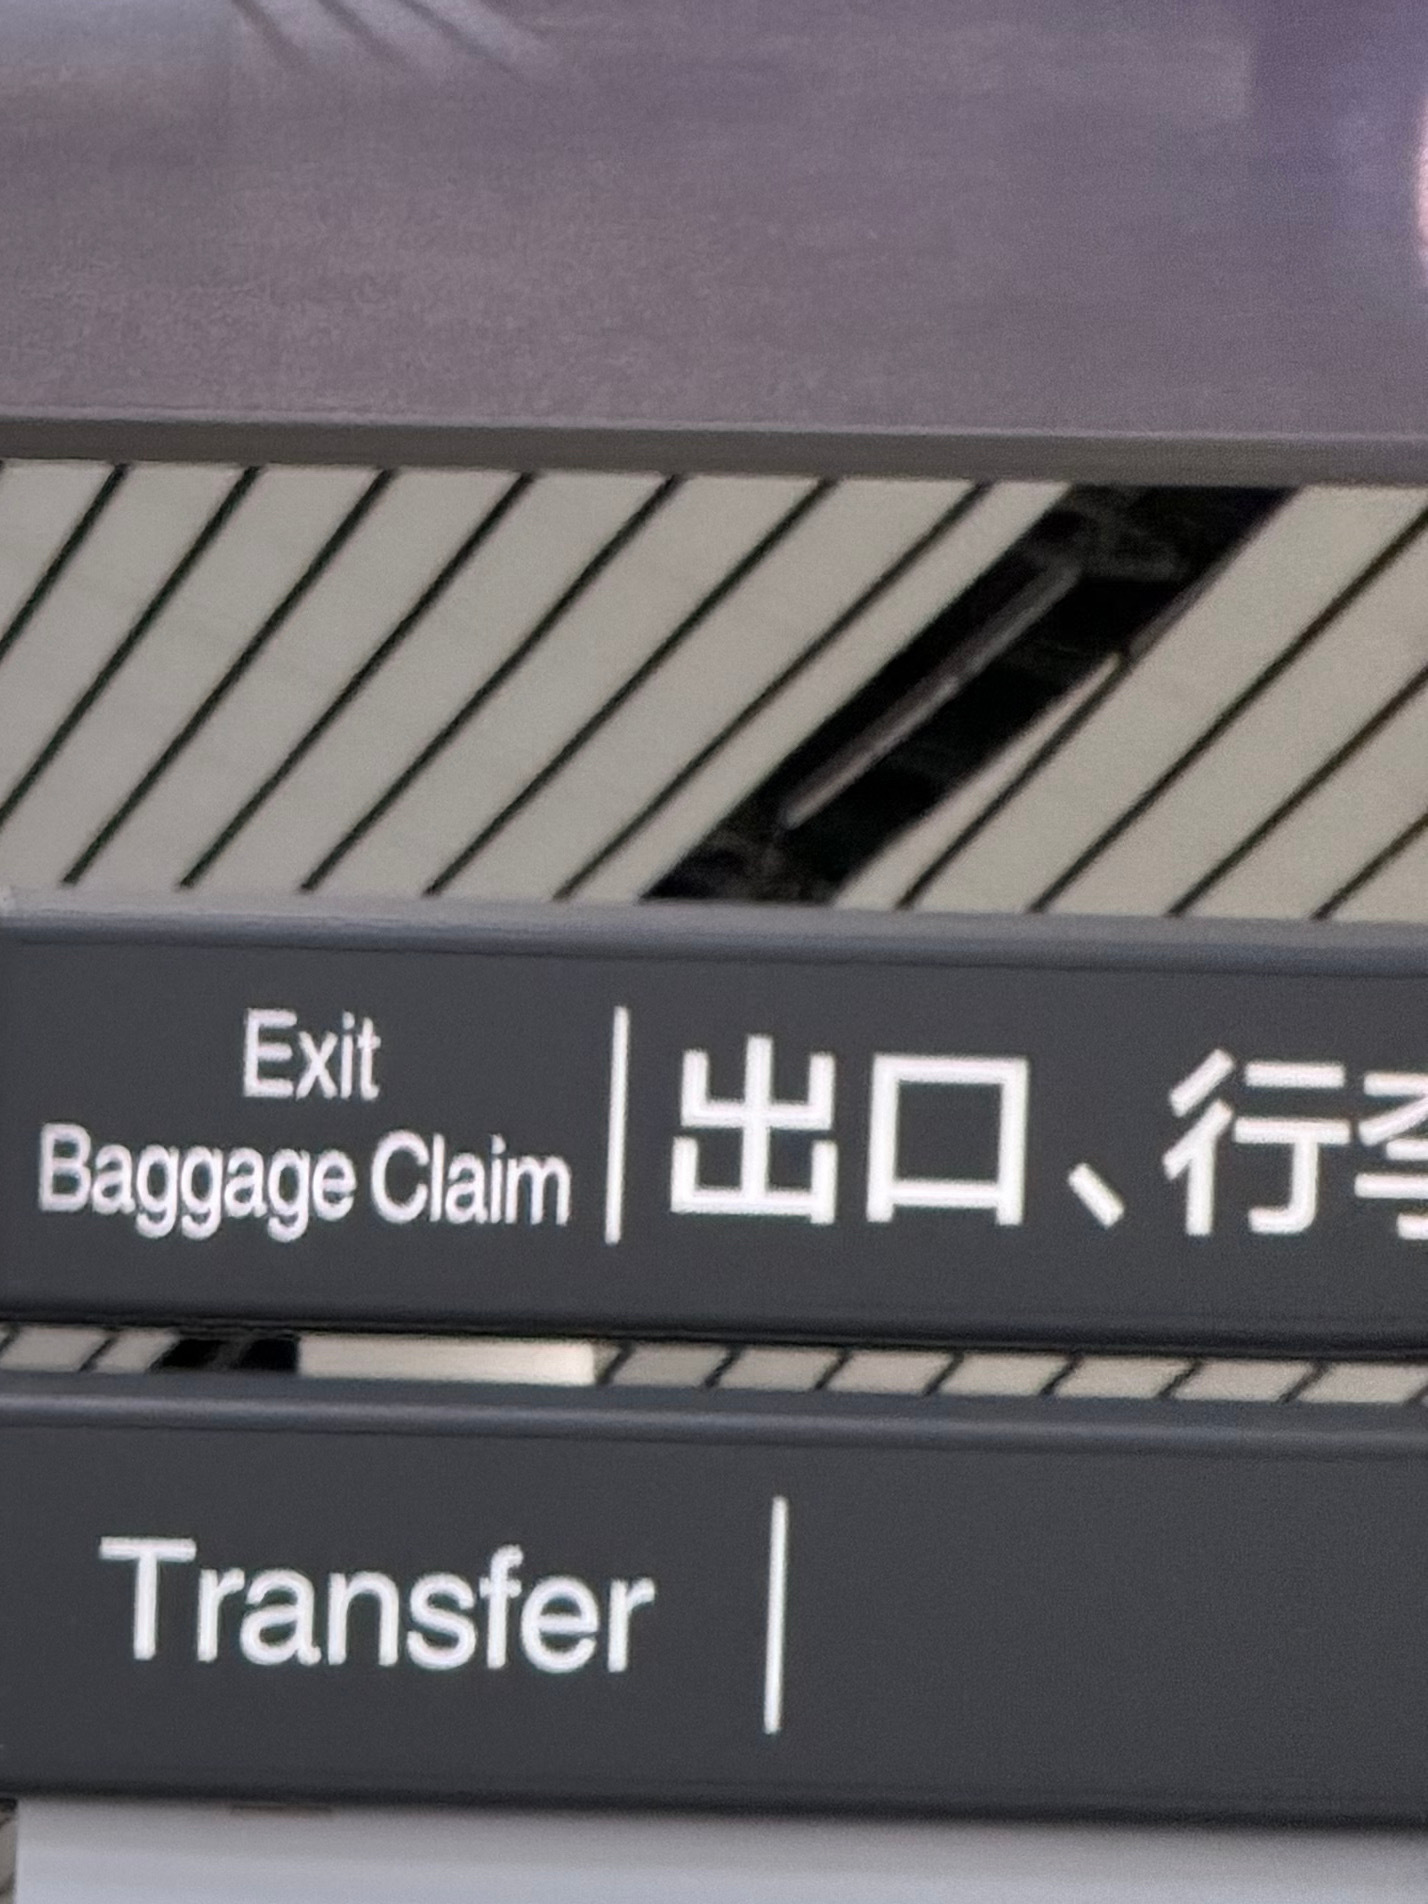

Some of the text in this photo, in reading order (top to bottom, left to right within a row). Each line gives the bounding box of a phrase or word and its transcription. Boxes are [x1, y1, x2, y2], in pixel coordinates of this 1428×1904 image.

[243, 1009, 381, 1107] Exit
[39, 1124, 571, 1242] Baggage Claim
[100, 1537, 655, 1675] Transfer
